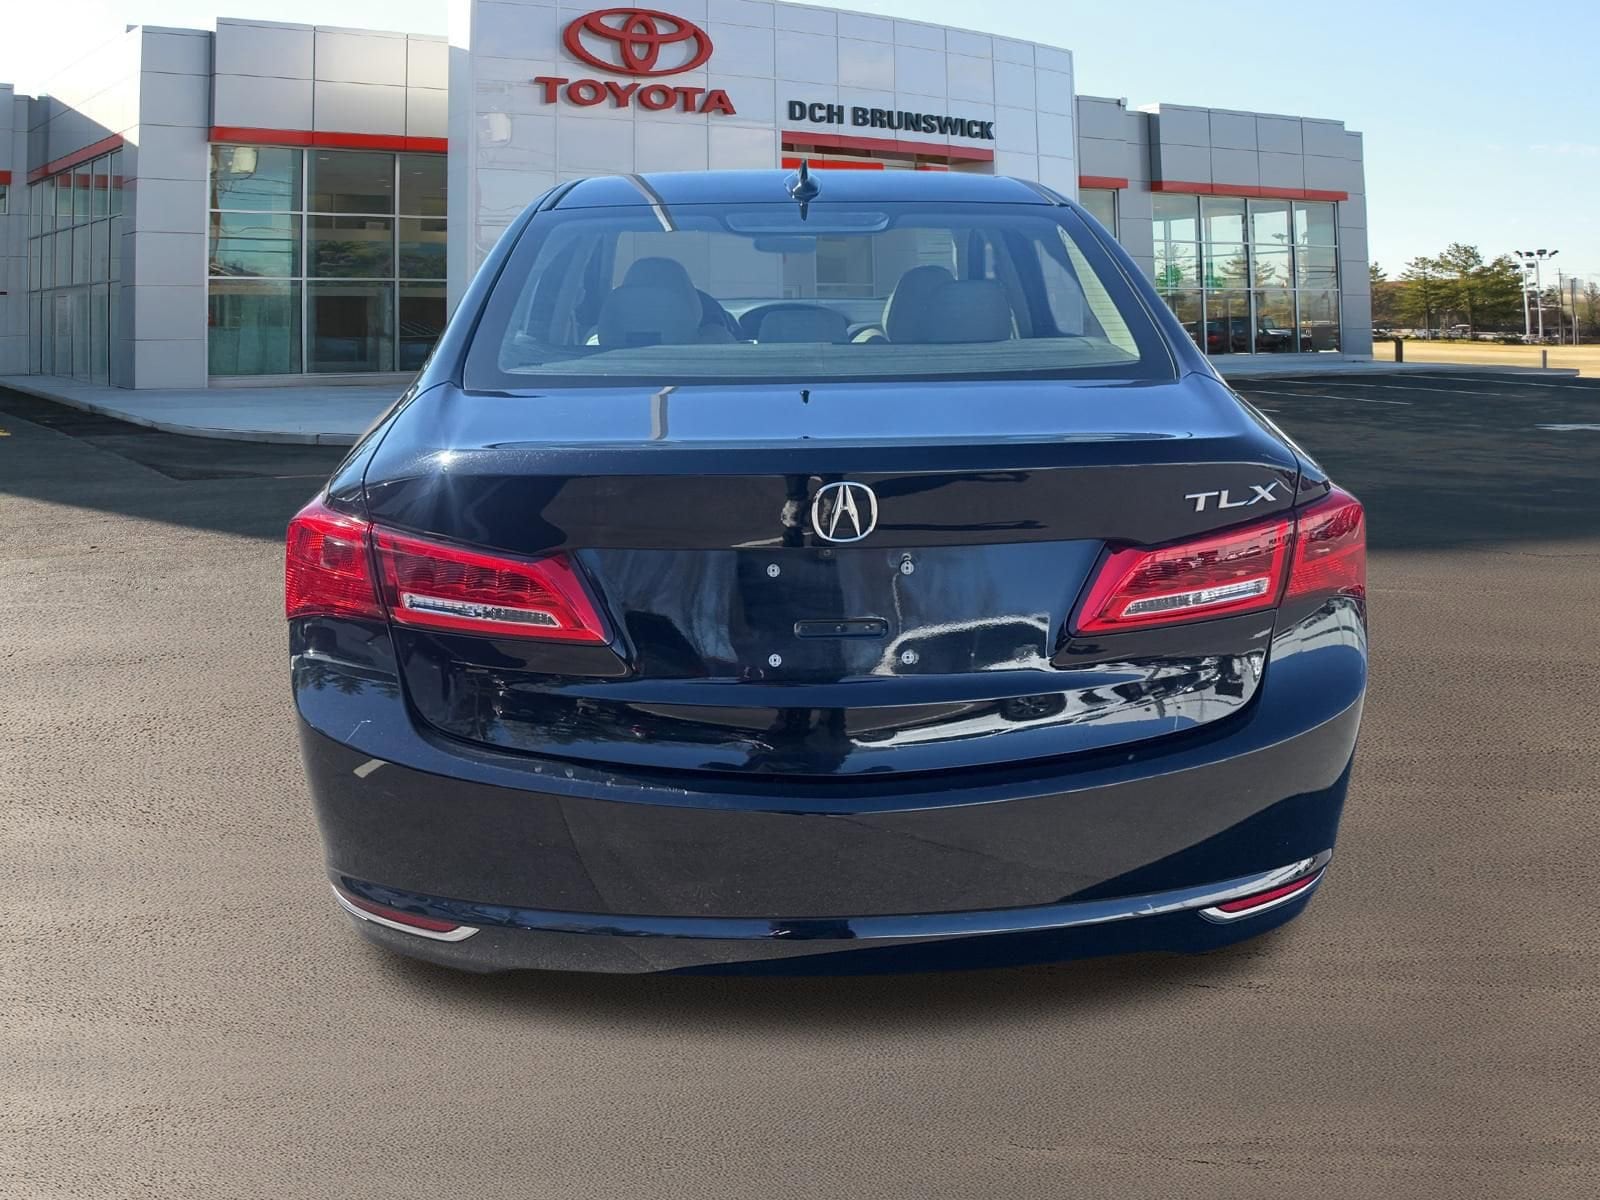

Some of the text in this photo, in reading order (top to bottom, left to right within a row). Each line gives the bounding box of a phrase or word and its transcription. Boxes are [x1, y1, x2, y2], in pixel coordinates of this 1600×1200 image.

[534, 76, 737, 115] TOYOTA
[787, 100, 995, 140] DCH BRUNSWICK
[1184, 481, 1279, 512] TLX
